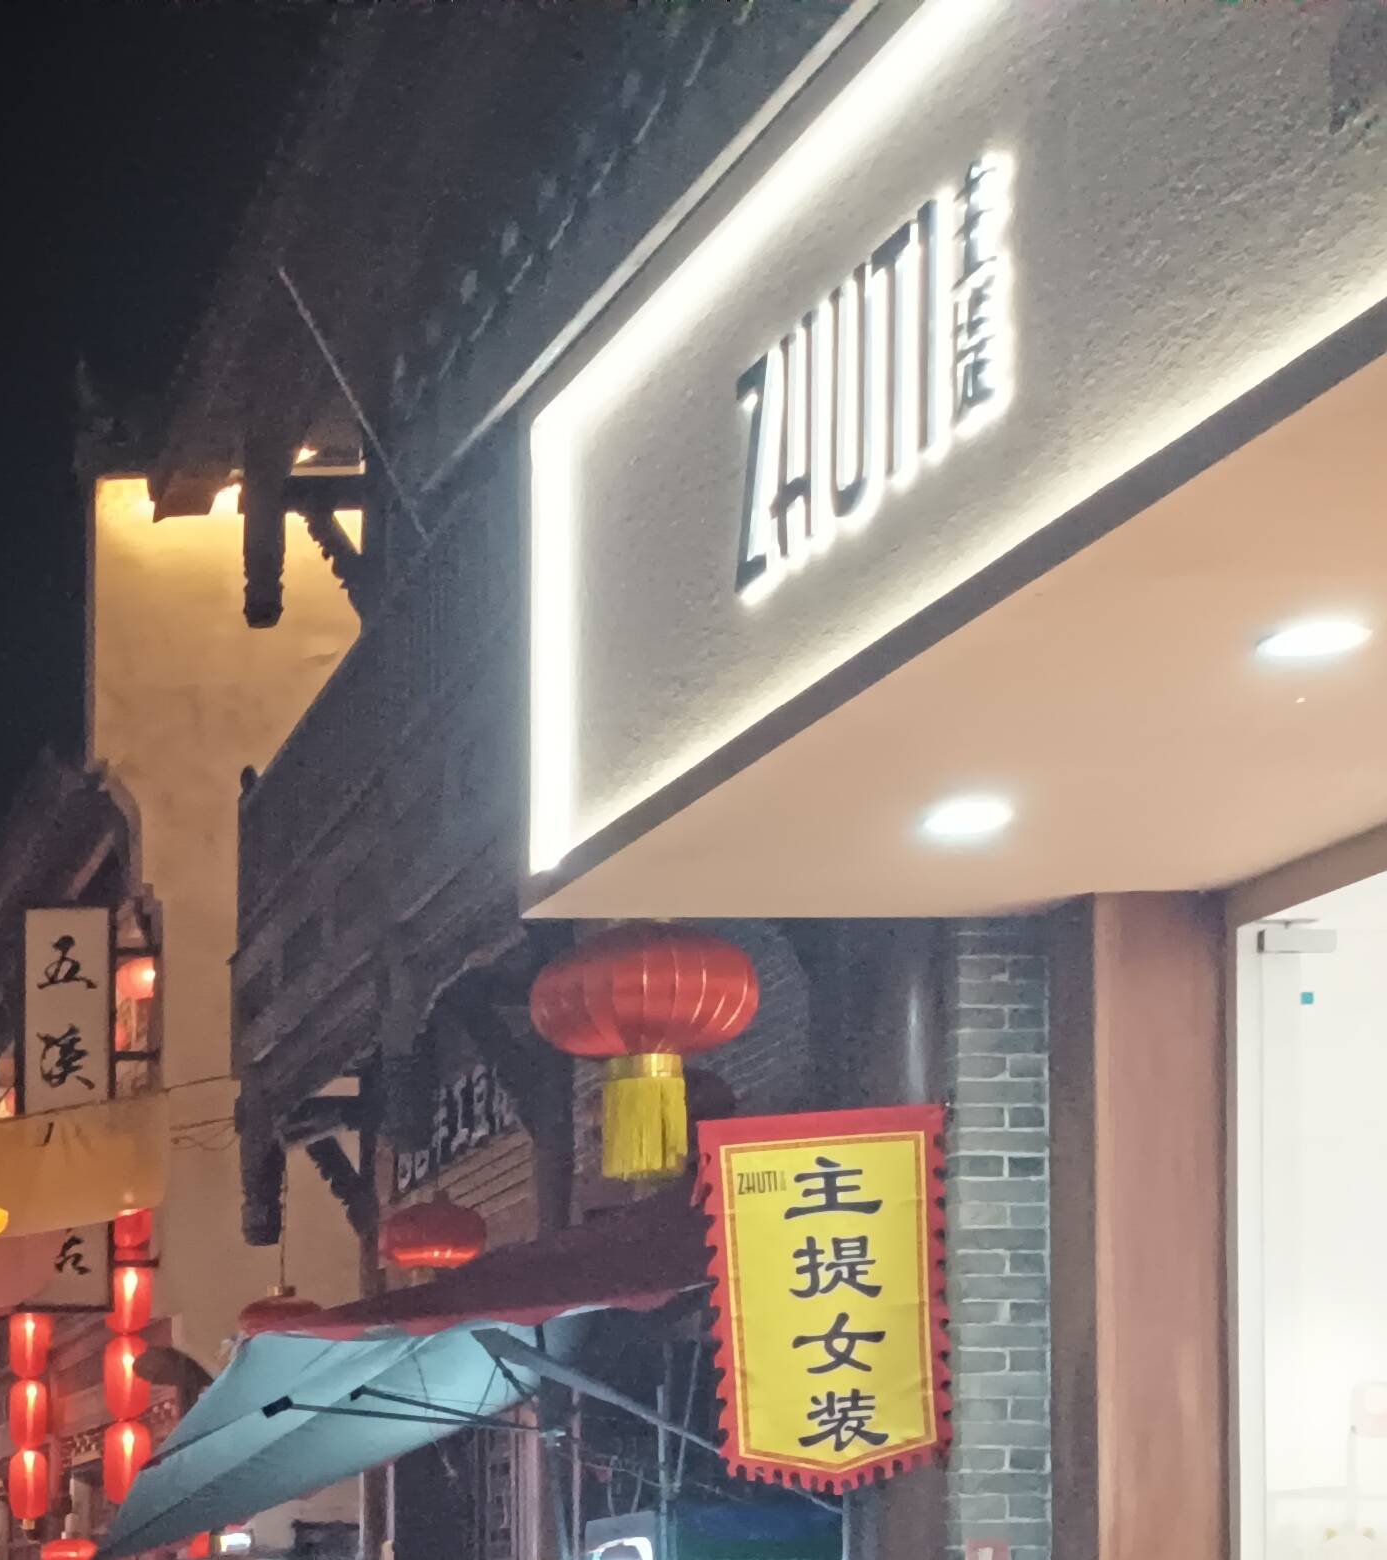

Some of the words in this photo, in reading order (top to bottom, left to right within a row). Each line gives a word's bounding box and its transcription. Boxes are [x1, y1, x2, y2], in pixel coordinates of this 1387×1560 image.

[733, 198, 943, 598] ZHUTI
[737, 1170, 778, 1196] ZHUTI
[783, 1155, 889, 1453] 主提女装
